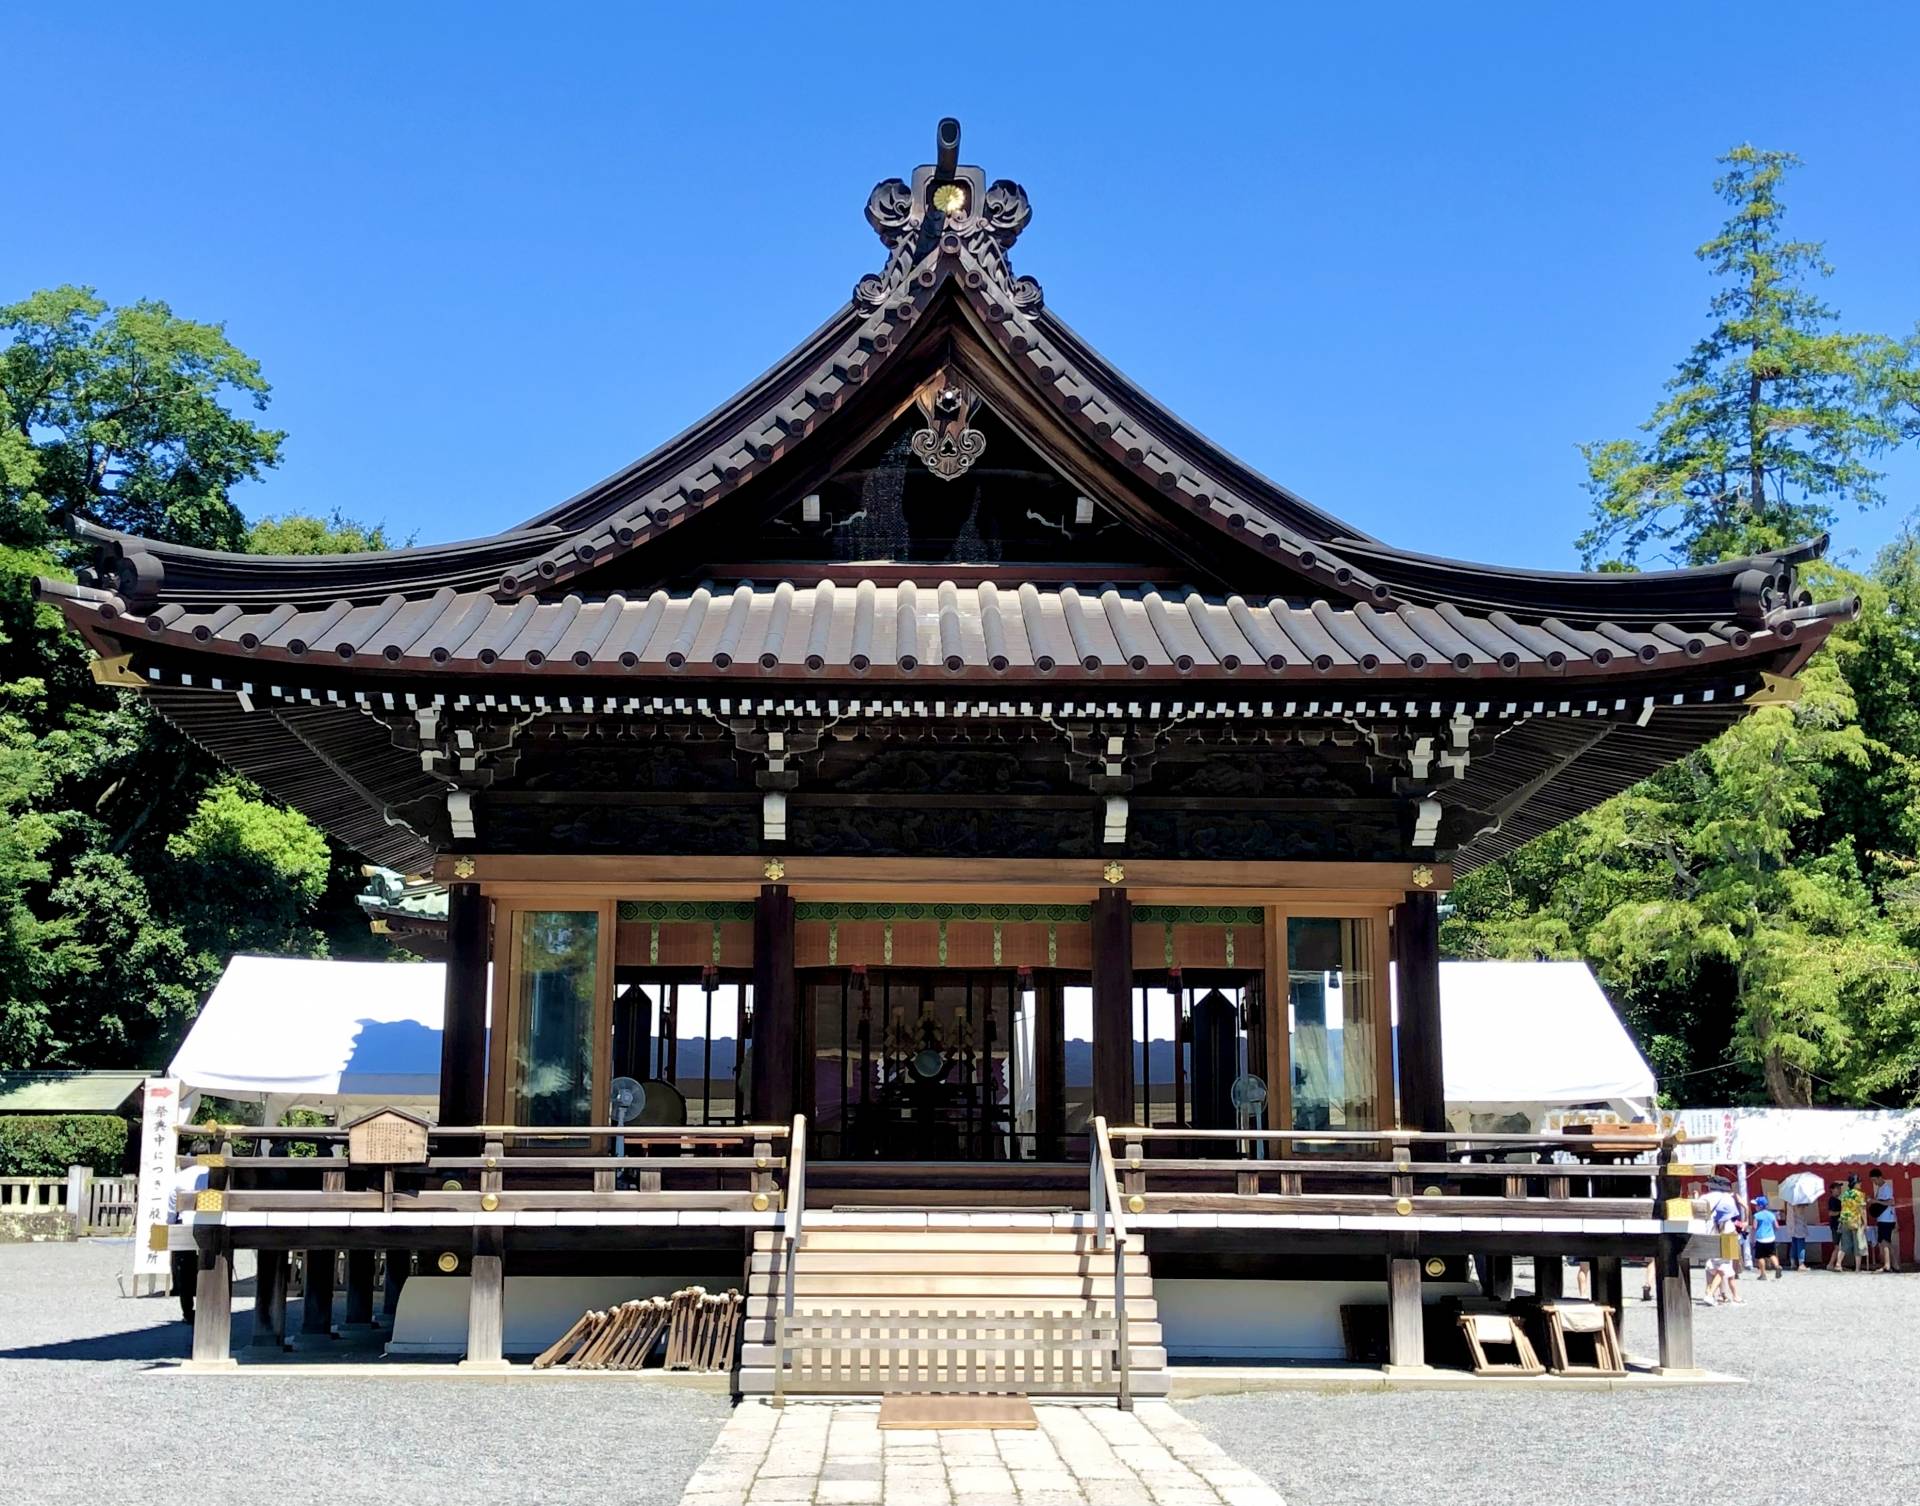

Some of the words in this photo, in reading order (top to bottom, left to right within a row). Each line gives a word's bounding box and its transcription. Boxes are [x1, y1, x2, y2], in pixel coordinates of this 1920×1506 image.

[146, 1105, 168, 1264] 祭典中につき一般所
